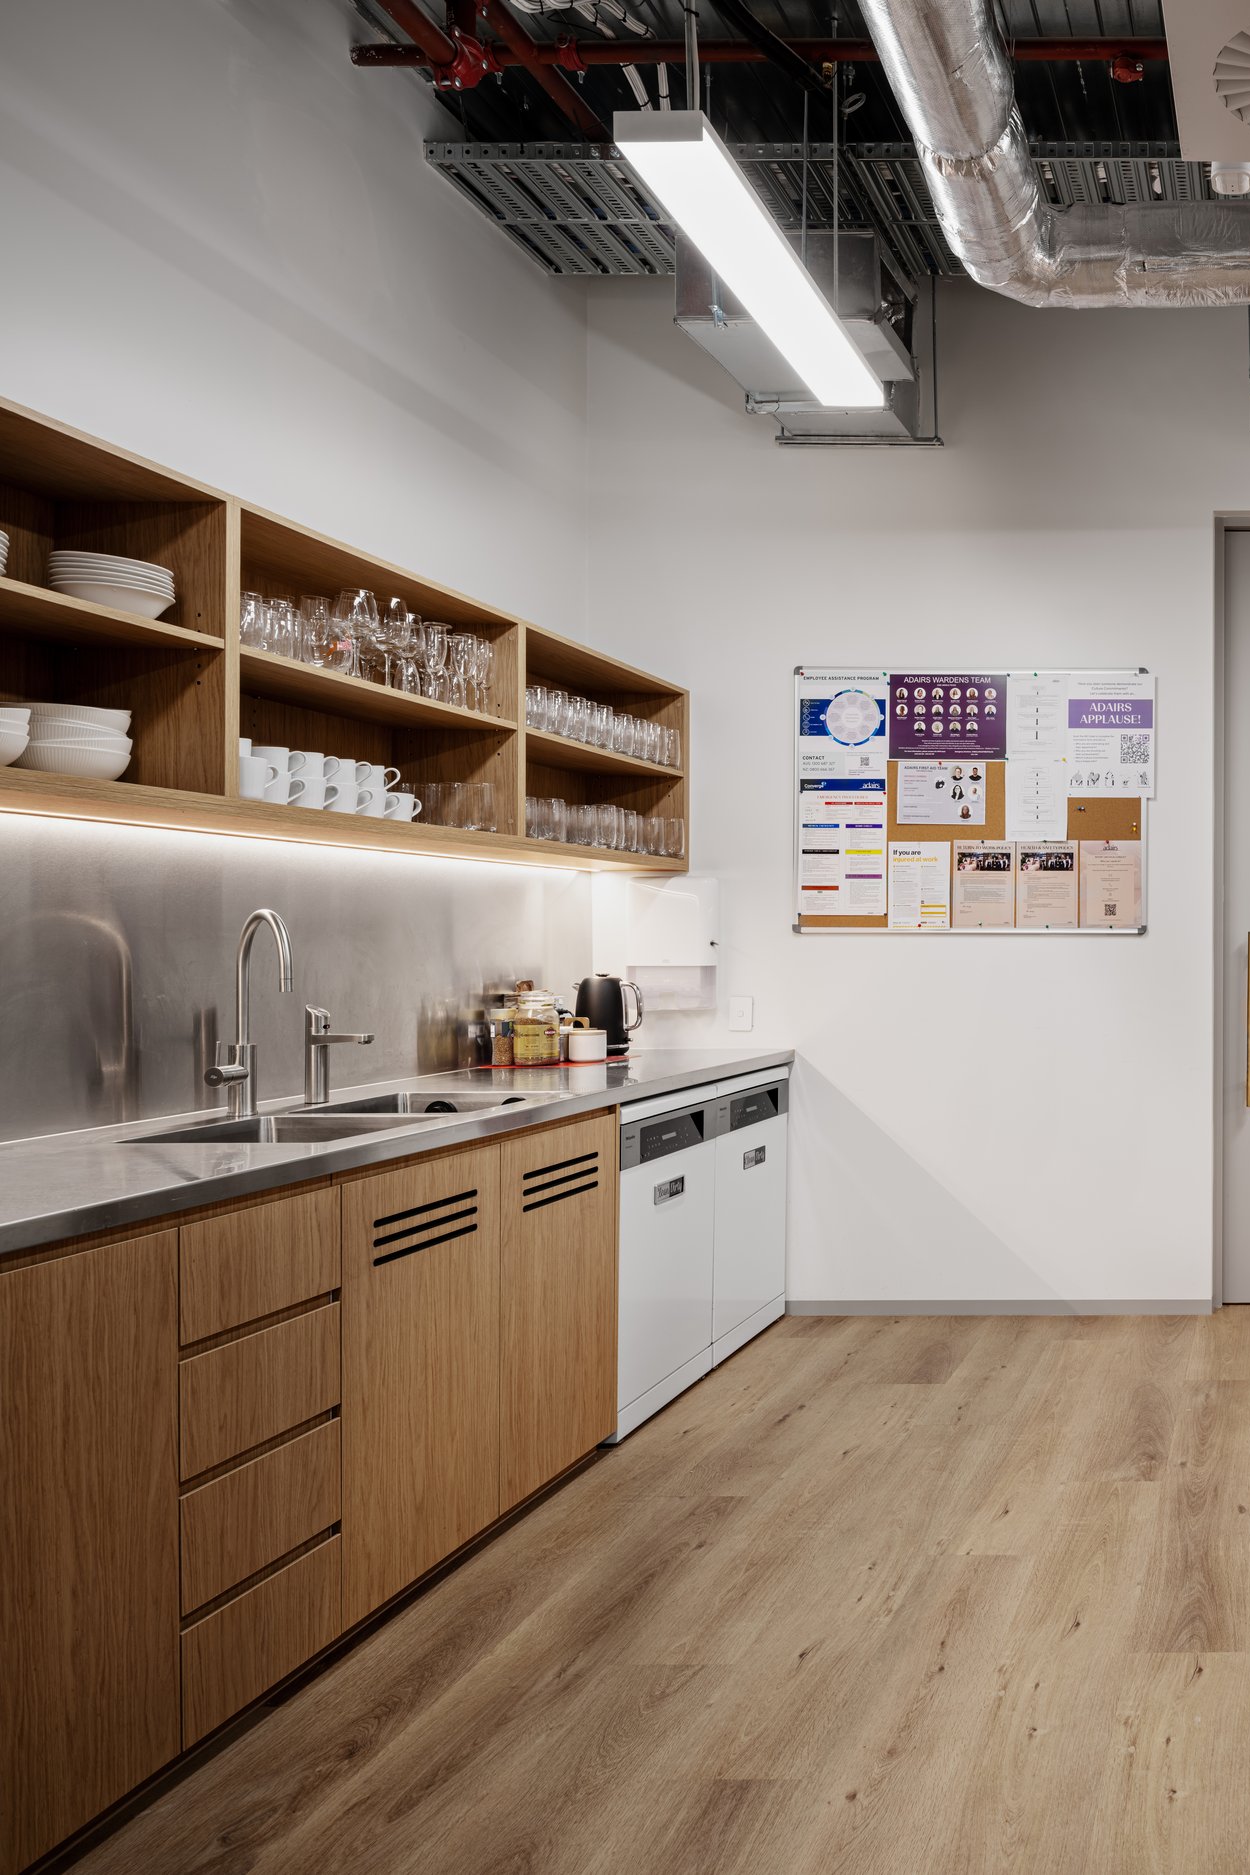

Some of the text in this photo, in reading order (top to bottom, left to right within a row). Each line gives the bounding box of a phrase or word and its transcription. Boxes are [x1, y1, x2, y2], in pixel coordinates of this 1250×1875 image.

[903, 676, 992, 684] ADAIRS WARDENS TEAM
[1089, 702, 1132, 712] ADAIRS
[1080, 714, 1141, 724] APPLAUSE!
